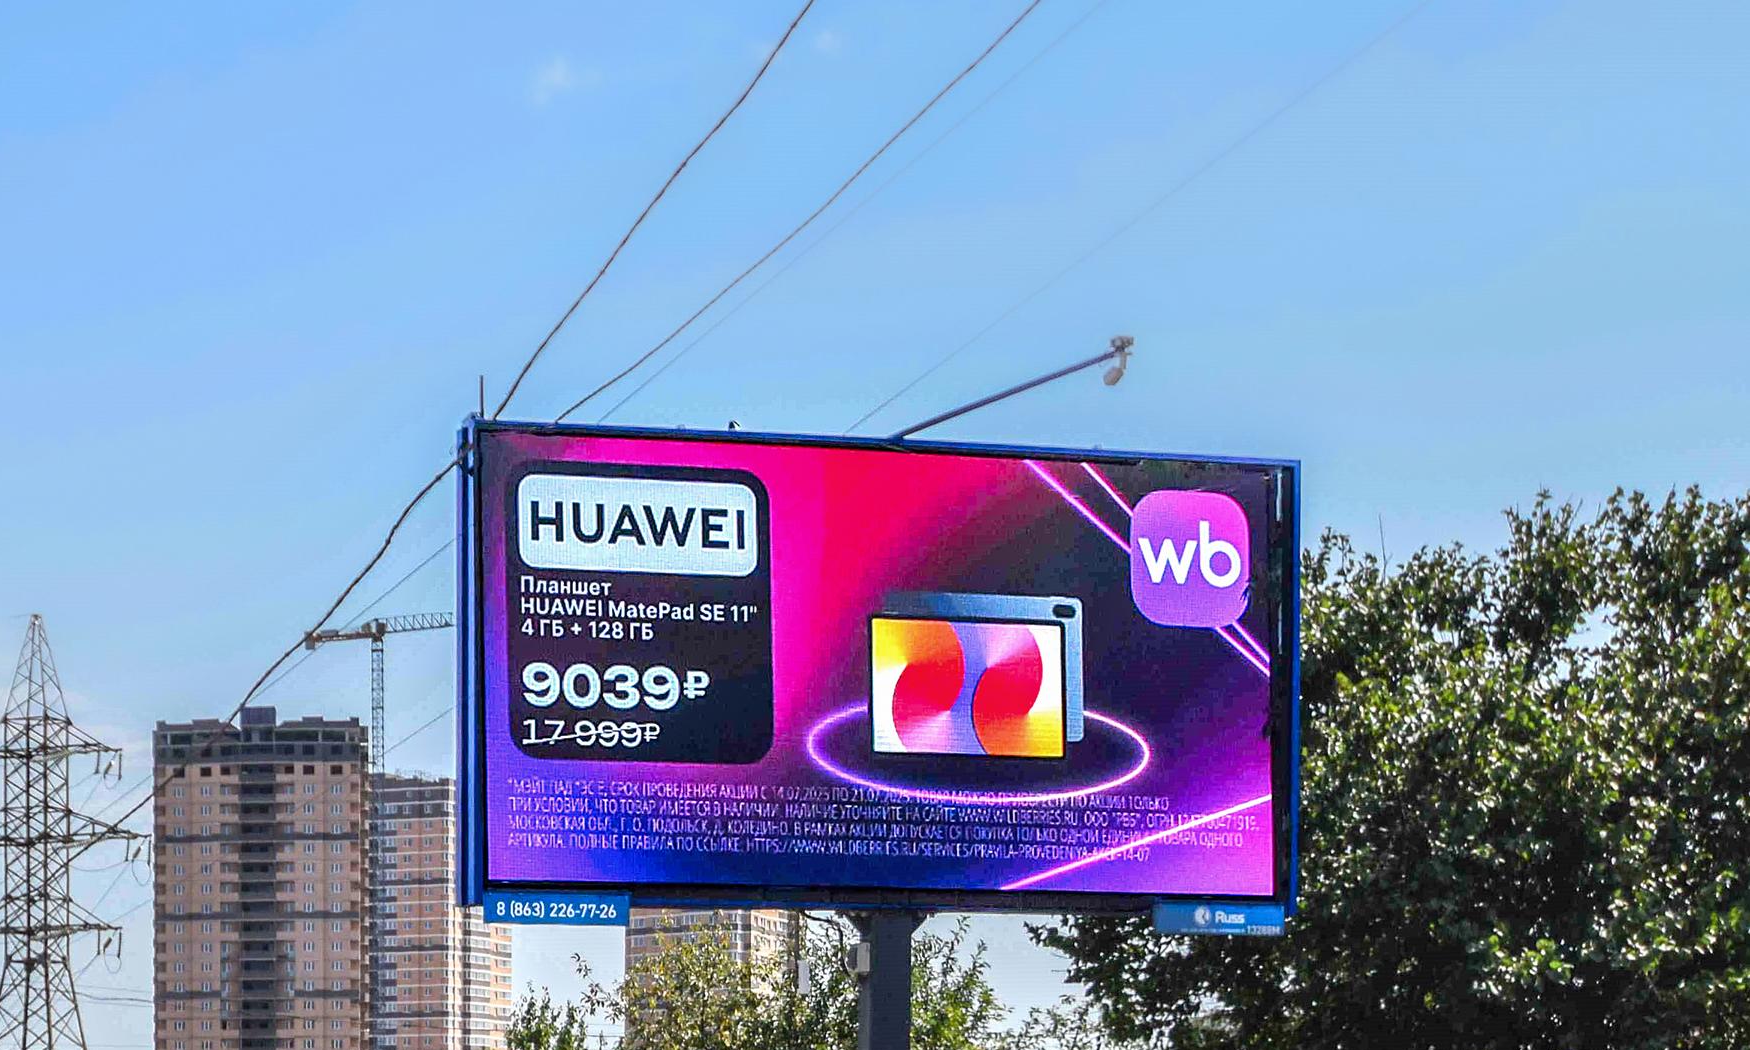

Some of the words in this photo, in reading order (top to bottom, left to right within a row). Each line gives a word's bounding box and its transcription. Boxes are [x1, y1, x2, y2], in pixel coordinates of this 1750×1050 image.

[530, 500, 746, 550] HUAWEI
[1138, 520, 1242, 588] wb
[520, 576, 612, 596] Планшет
[520, 598, 603, 618] HUAWEI
[608, 600, 695, 621] MatePad
[699, 604, 725, 622] SE
[730, 605, 758, 623] 11"
[521, 618, 534, 636] 4
[539, 619, 565, 638] ГБ
[570, 623, 582, 635] +
[590, 621, 625, 639] 128
[629, 622, 655, 640] ГБ
[496, 901, 506, 917] 8
[510, 900, 545, 918] (863)
[549, 902, 618, 919] 226-77-26
[1214, 910, 1246, 924] Russ
